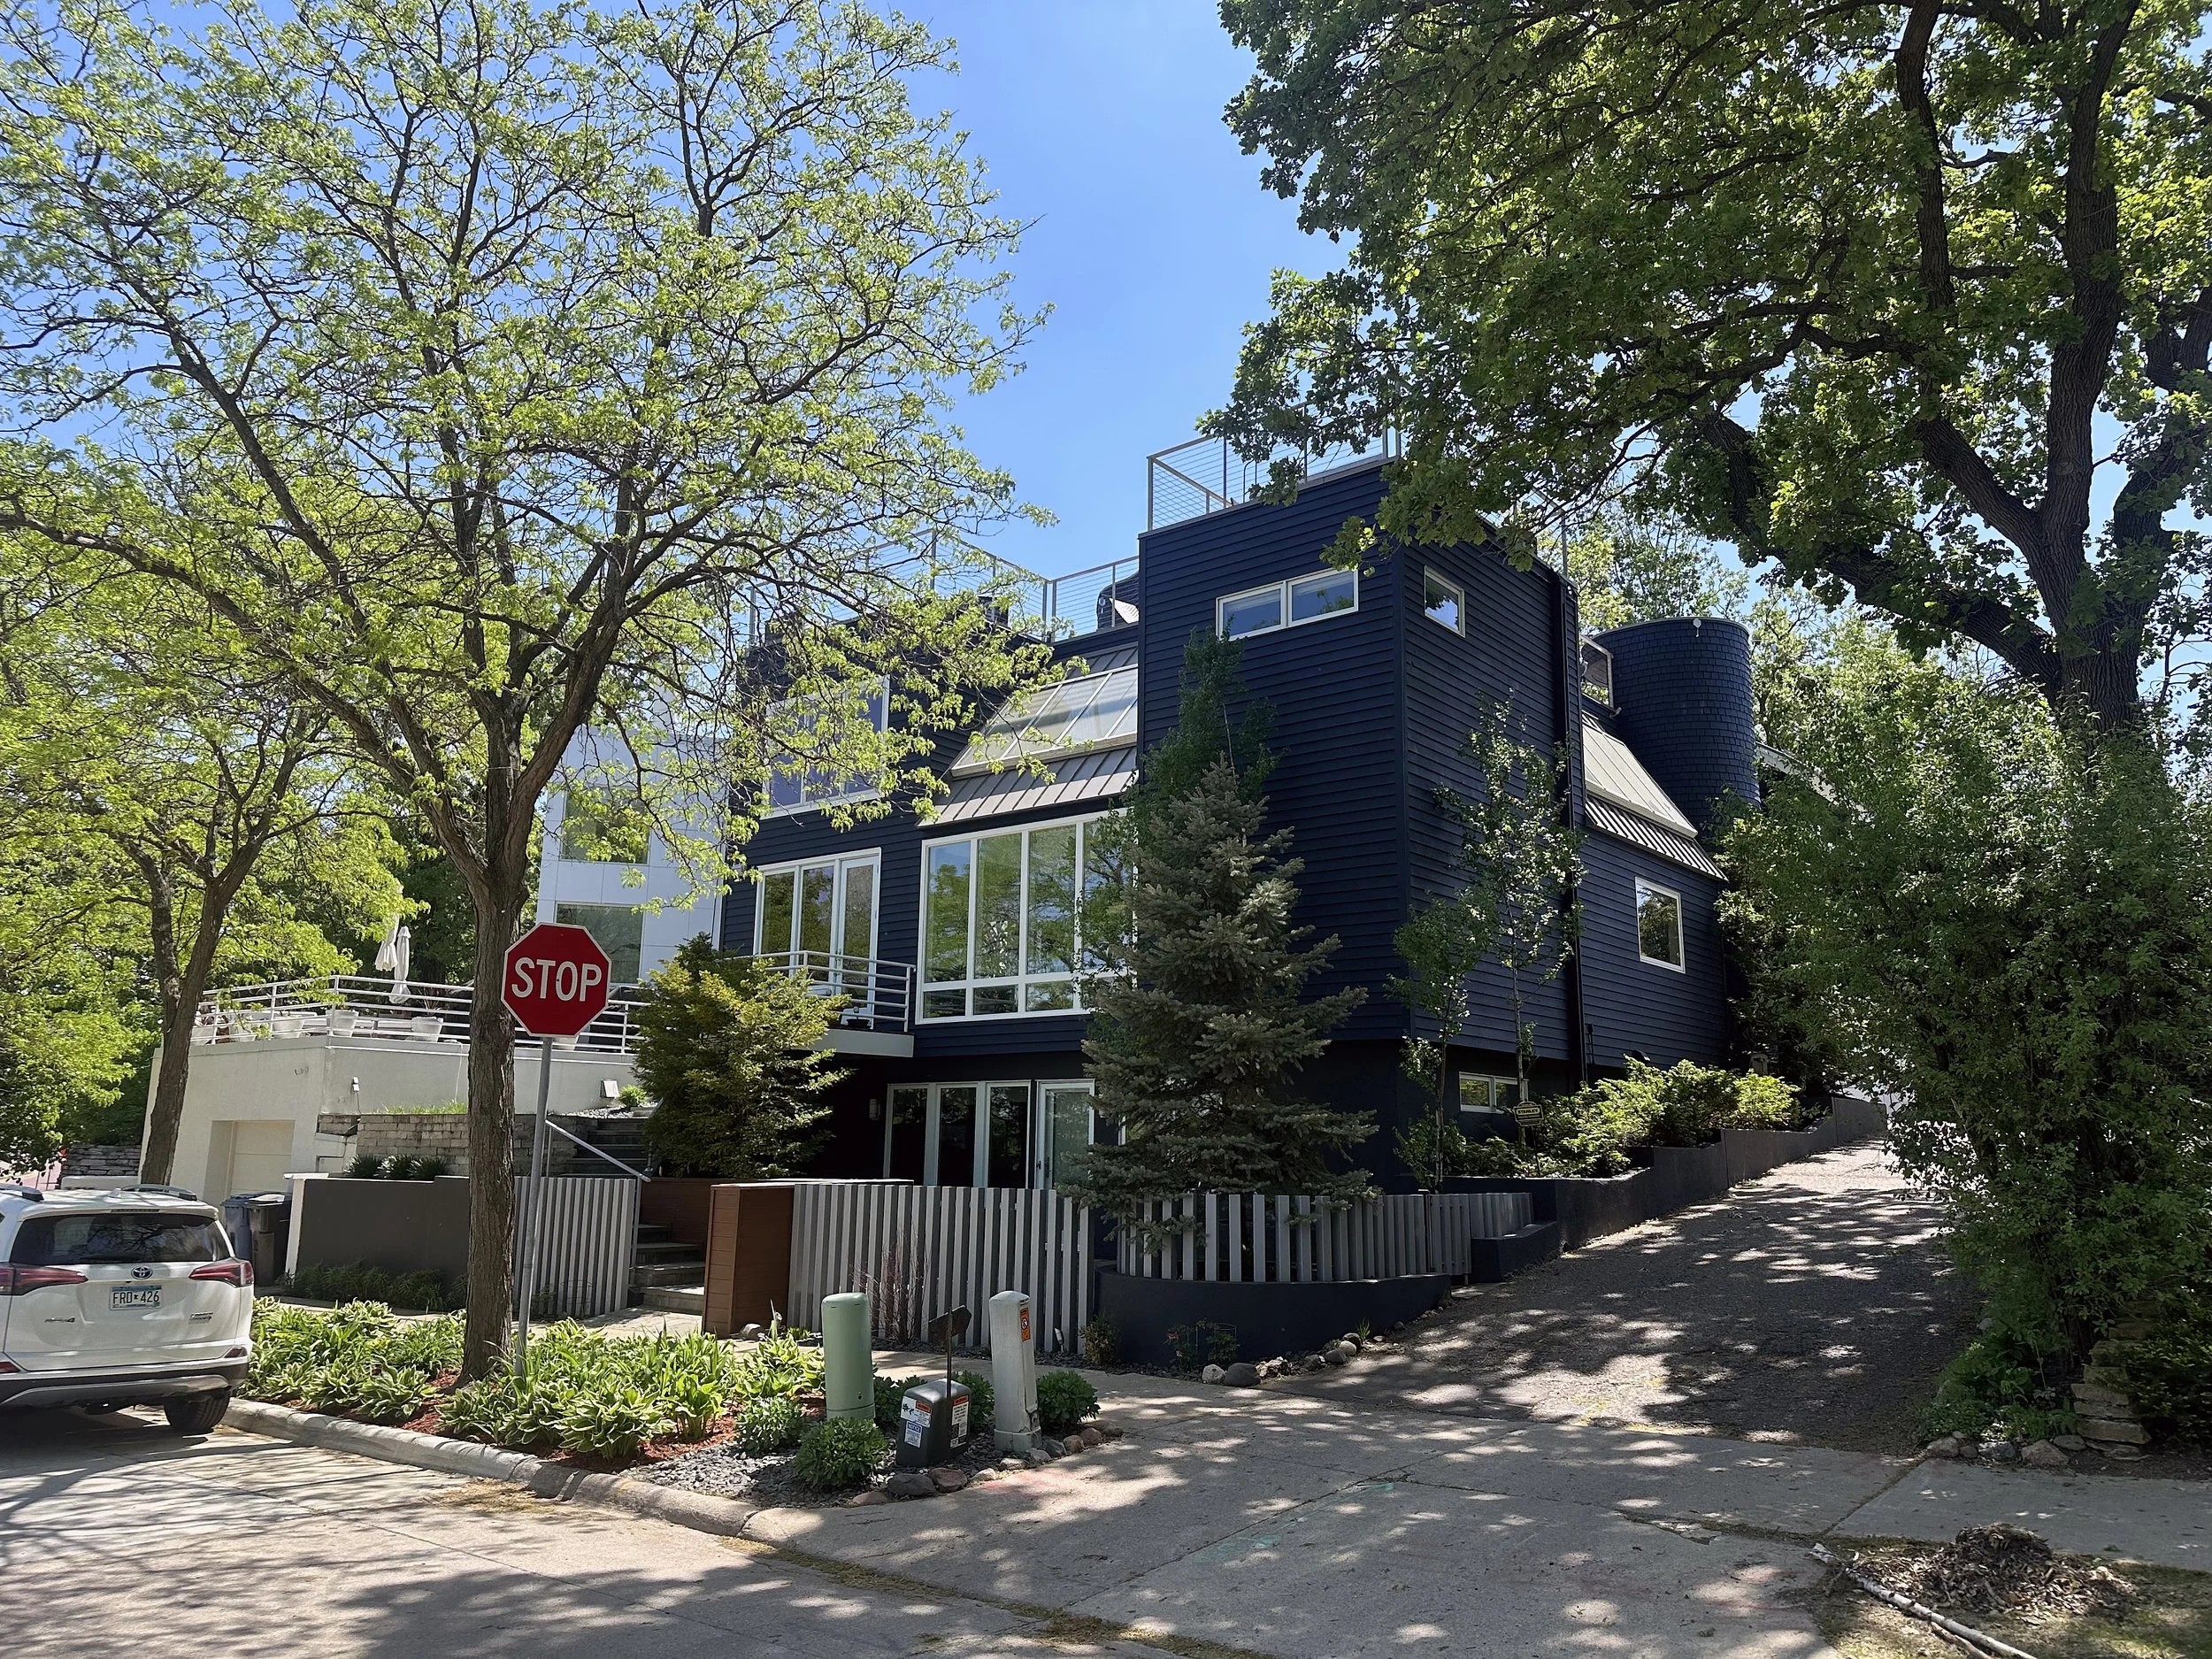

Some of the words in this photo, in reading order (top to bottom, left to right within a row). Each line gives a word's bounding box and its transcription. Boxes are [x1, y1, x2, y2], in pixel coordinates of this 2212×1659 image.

[511, 956, 603, 1002] STOP
[112, 1292, 133, 1304] FRD
[140, 1290, 160, 1303] 426
